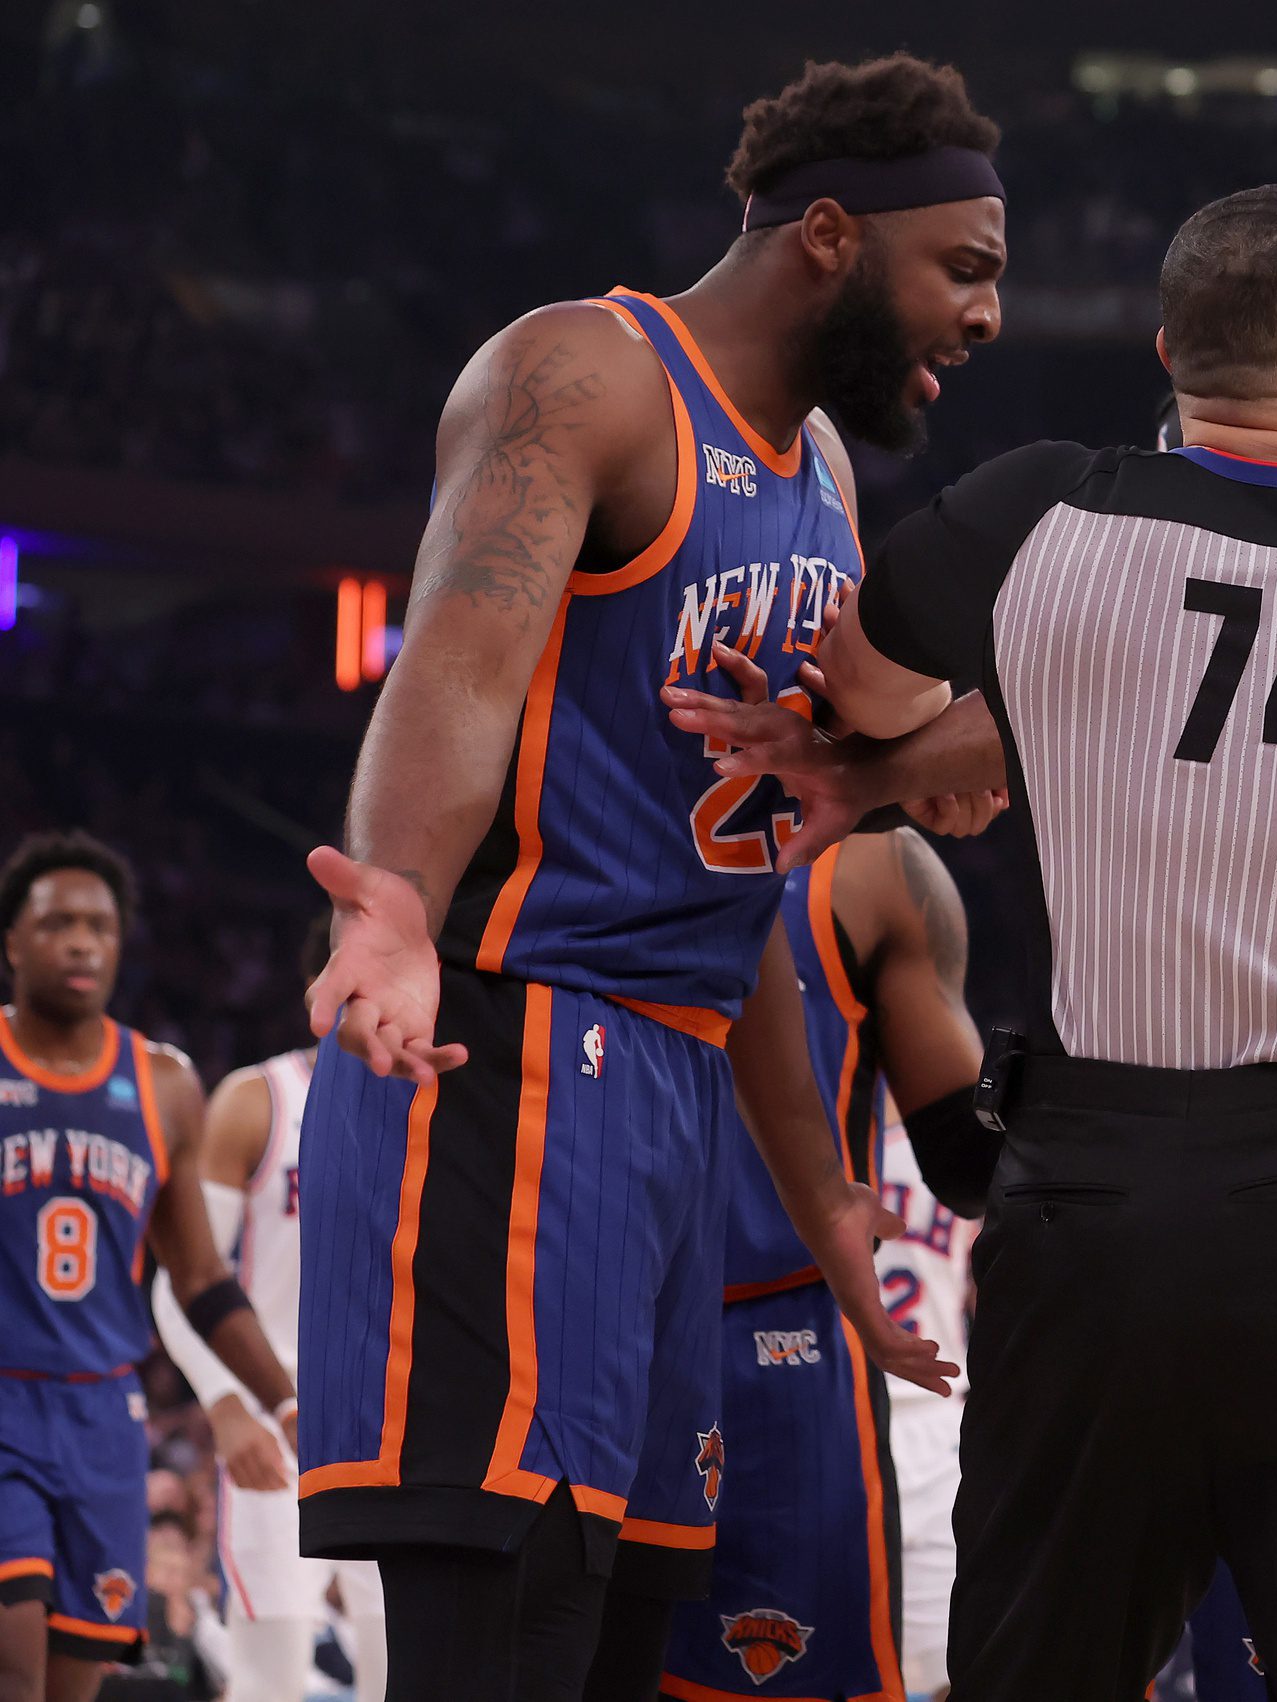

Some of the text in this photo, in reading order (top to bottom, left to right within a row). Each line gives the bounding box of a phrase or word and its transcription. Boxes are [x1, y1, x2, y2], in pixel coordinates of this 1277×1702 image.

[702, 443, 757, 498] NYC
[664, 562, 779, 686] NEW
[0, 1128, 59, 1196] EW
[36, 1196, 98, 1301] 8
[753, 1329, 821, 1366] NYC
